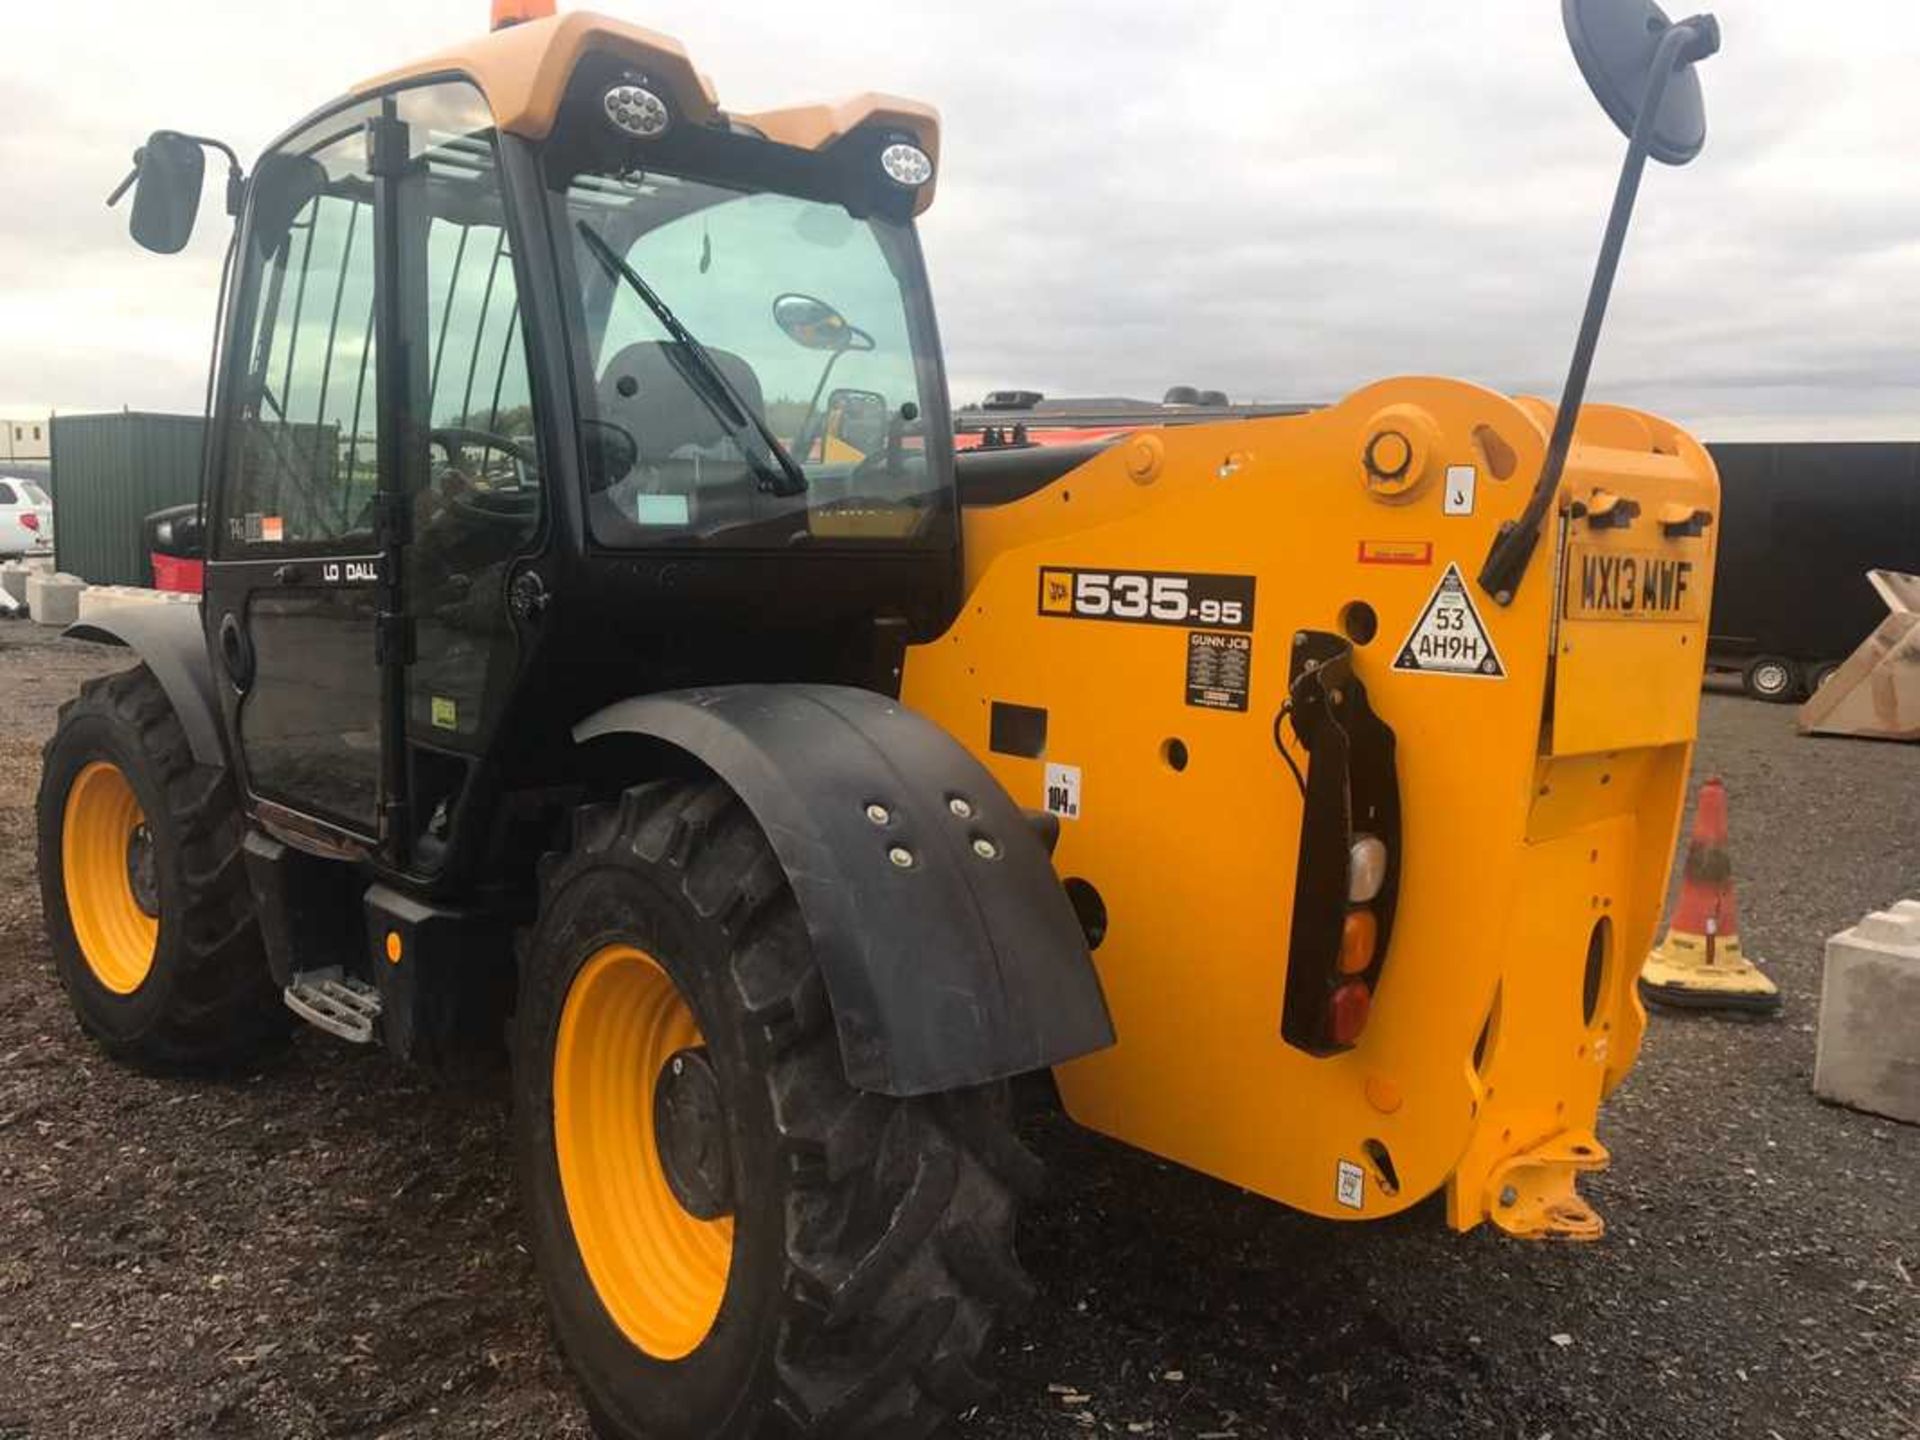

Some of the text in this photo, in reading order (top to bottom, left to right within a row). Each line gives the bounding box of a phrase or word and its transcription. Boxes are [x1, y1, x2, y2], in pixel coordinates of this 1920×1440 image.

[1582, 555, 1692, 611] MX13 MWF
[1437, 608, 1464, 631] 53
[1191, 634, 1249, 650] GUNN JCB
[1419, 634, 1477, 660] AH9H
[1049, 786, 1068, 813] 104
